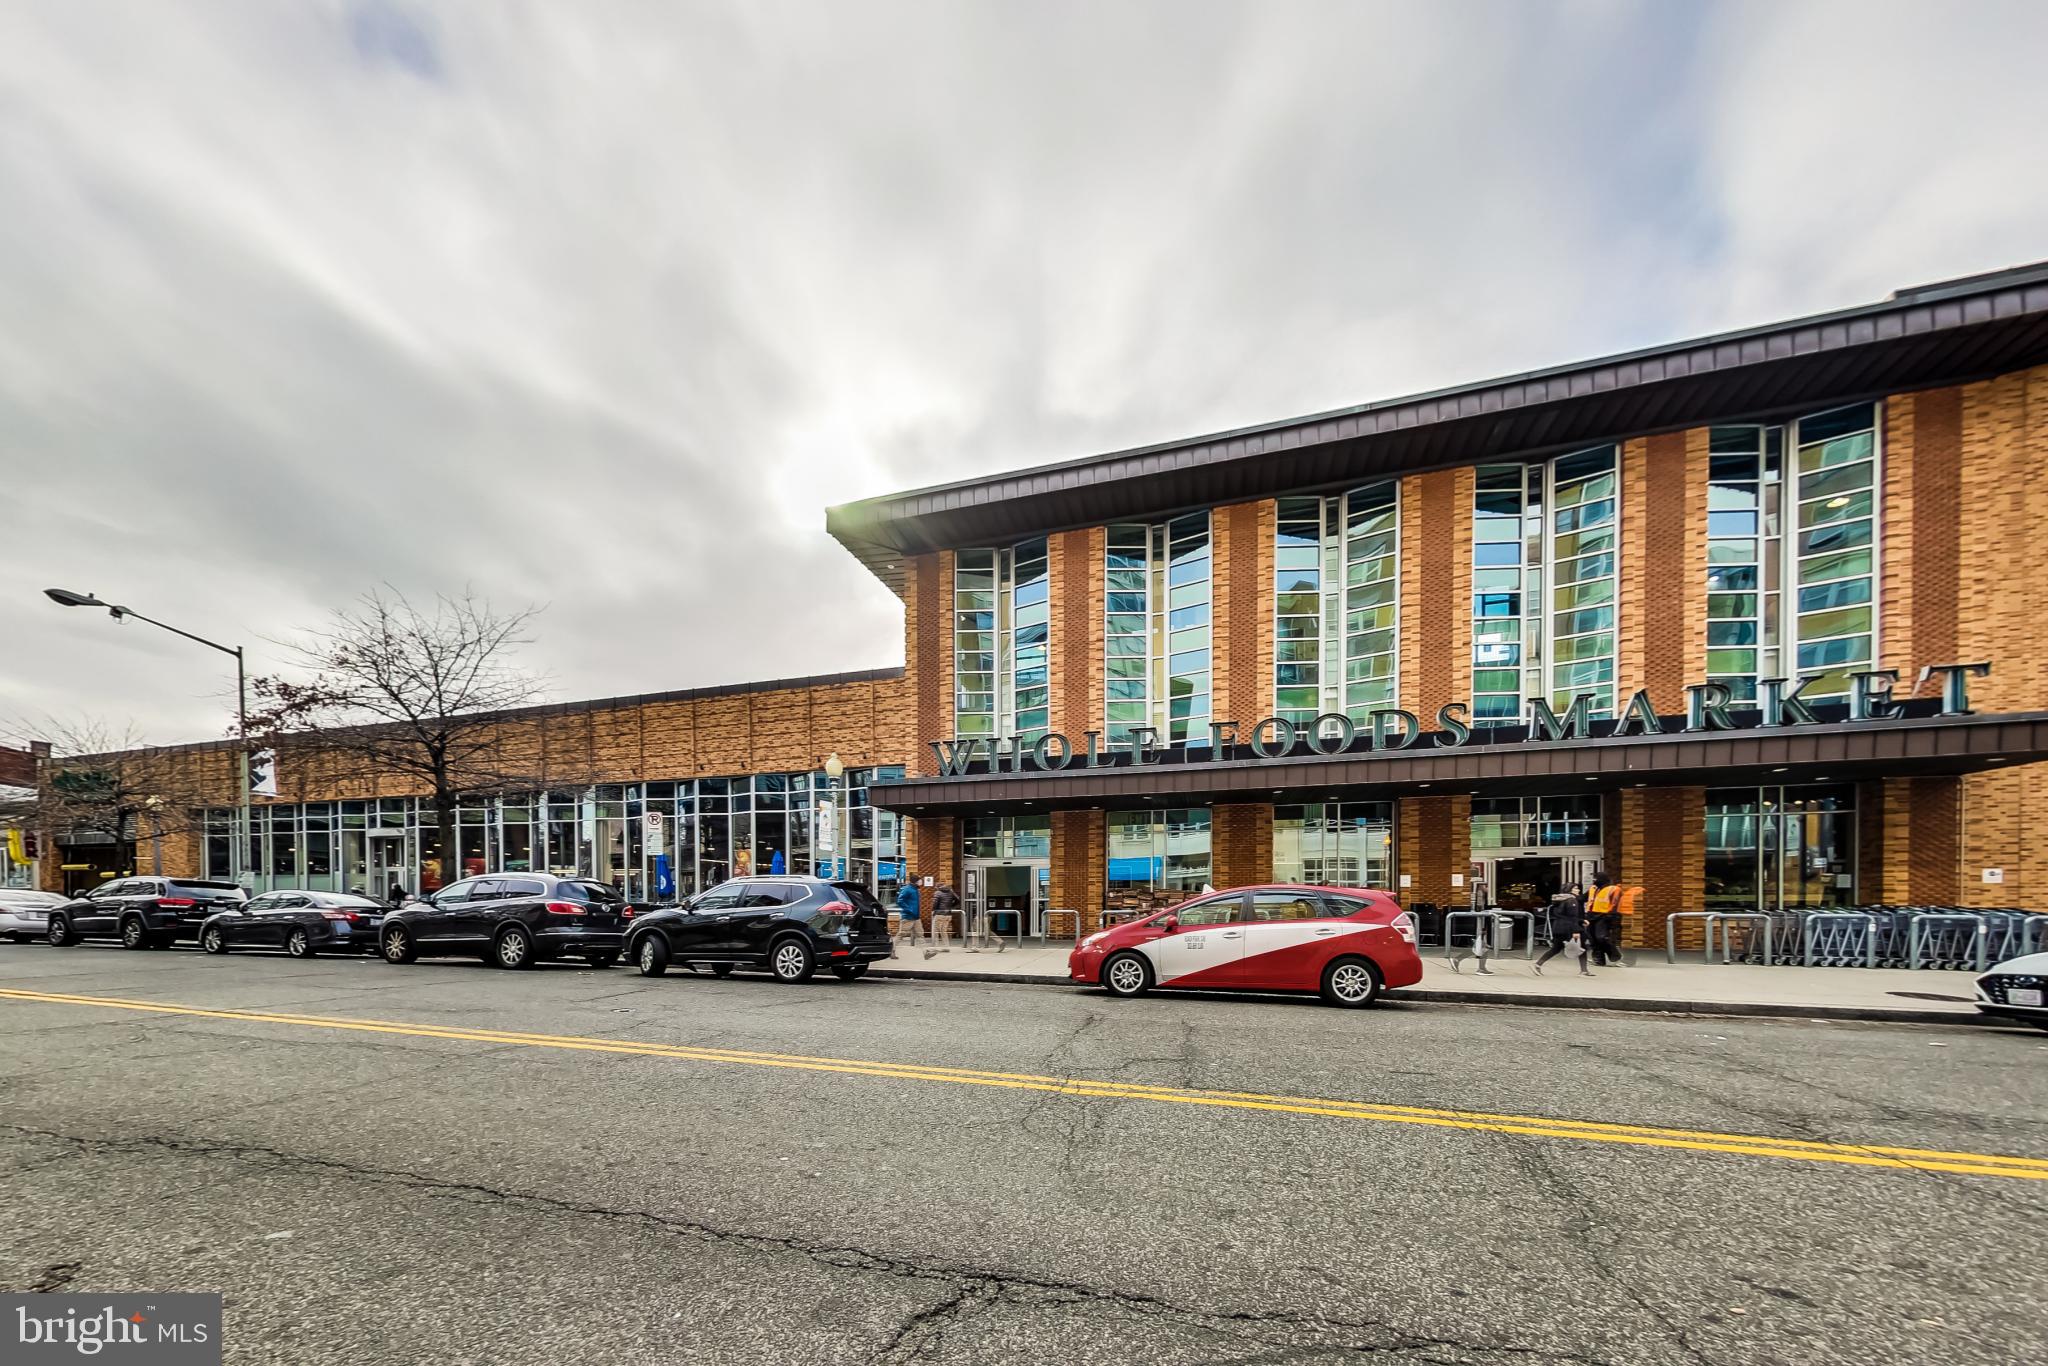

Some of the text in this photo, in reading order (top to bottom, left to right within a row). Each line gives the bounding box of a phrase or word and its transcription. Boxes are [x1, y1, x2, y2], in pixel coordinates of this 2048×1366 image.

[928, 661, 1990, 776] WHOLE FOODS MARKET
